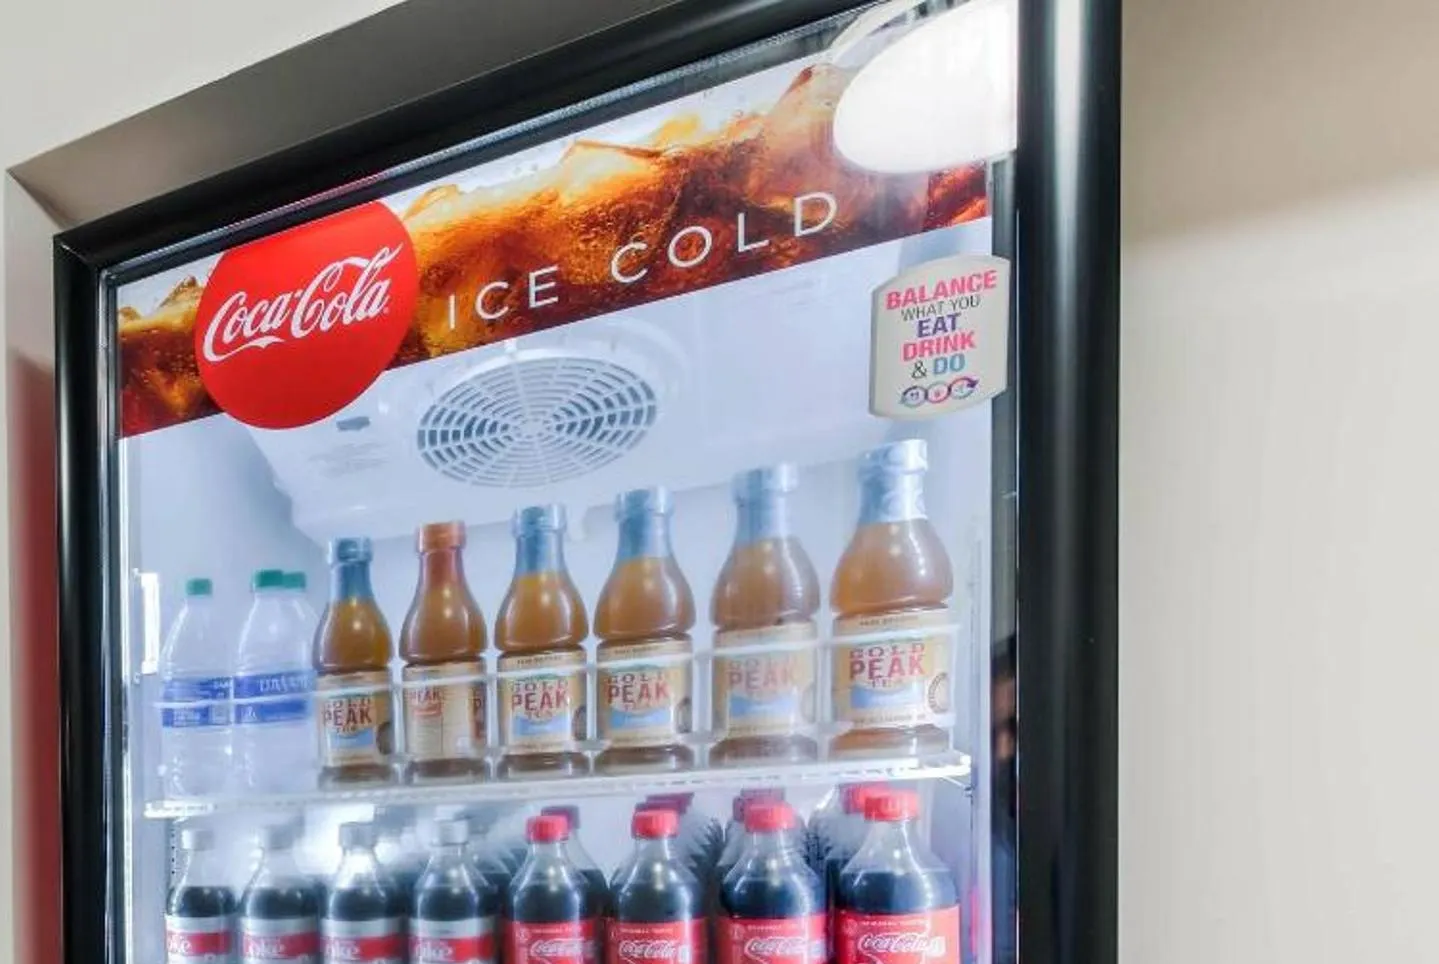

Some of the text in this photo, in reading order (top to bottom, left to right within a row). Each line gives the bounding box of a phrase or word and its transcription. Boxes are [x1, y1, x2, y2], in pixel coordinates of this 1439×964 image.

[447, 191, 838, 330] ICE COLD
[202, 242, 404, 362] Coca-Cola
[885, 269, 998, 311] BALANCE
[901, 294, 981, 322] WHAT YOU
[916, 312, 962, 339] EAT
[902, 330, 977, 362] DRINK
[911, 353, 966, 380] & DO
[728, 666, 796, 691] PEAK
[848, 655, 926, 681] PEAK
[511, 689, 569, 712] PEAK
[606, 682, 671, 705] PEAK
[323, 707, 373, 727] PEAK
